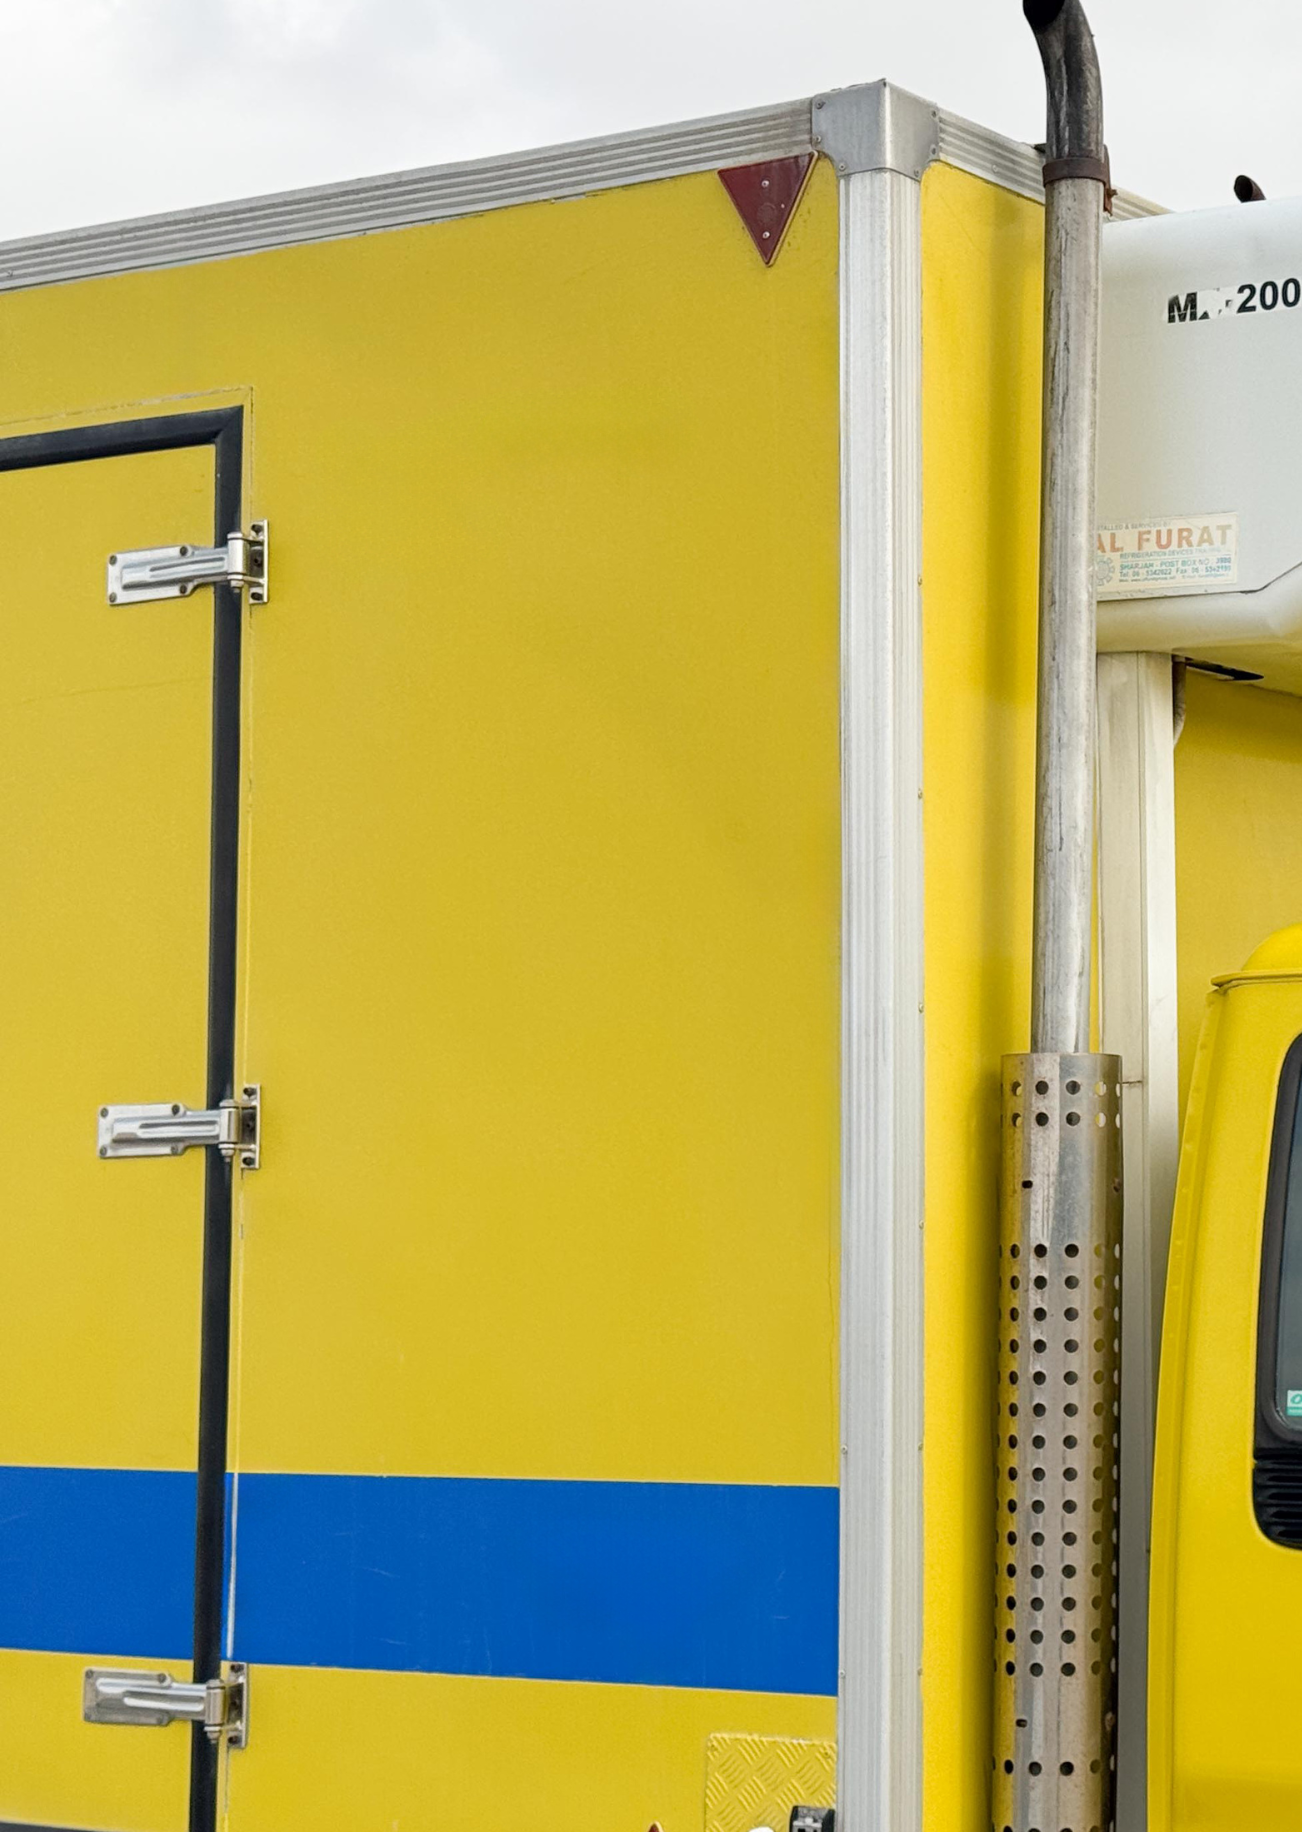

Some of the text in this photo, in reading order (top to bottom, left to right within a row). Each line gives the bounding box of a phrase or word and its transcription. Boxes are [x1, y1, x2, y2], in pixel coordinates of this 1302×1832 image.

[1138, 524, 1232, 551] FURAT
[1160, 560, 1179, 568] POST
[1181, 559, 1196, 567] BOX
